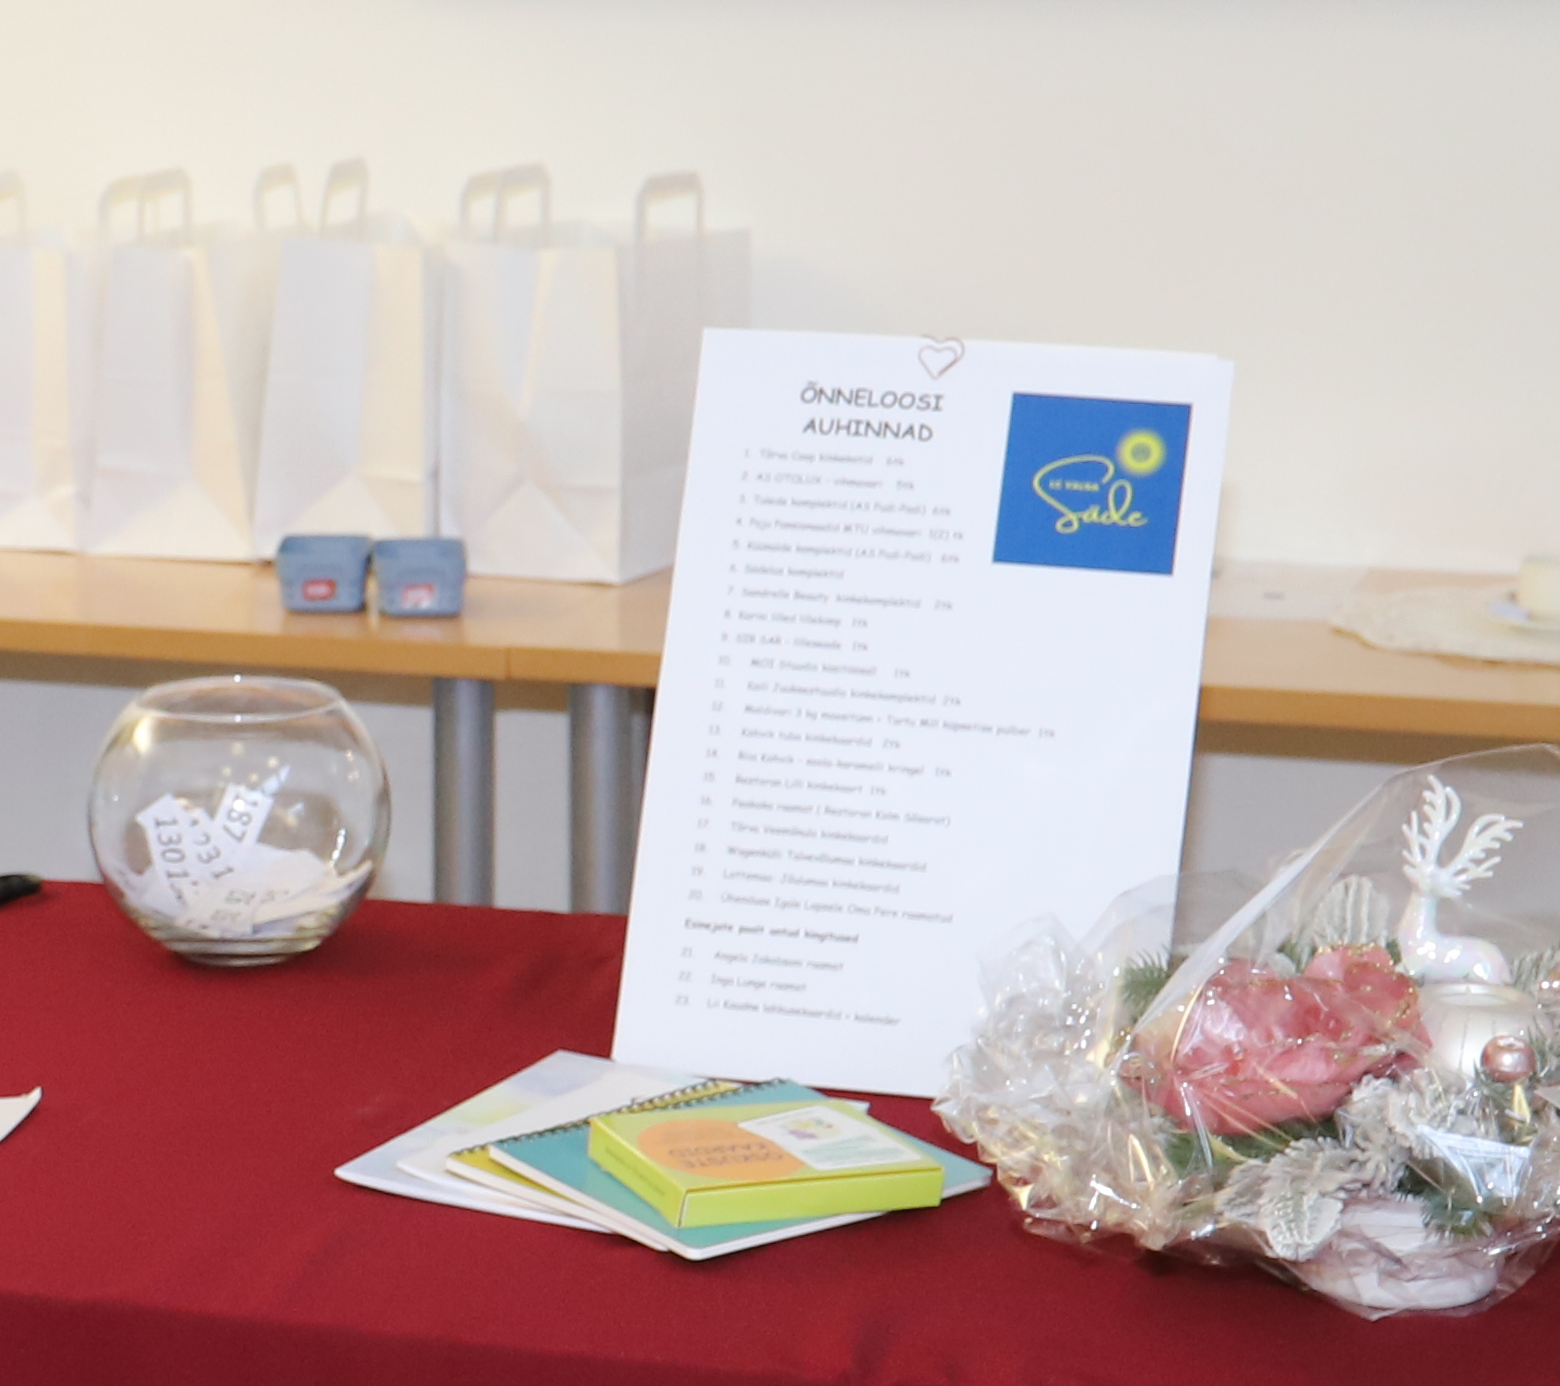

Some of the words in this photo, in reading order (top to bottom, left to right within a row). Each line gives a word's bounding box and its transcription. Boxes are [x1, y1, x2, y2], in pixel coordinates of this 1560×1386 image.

[800, 380, 944, 412] ÕNNELOOSI
[802, 417, 933, 442] AUHINNAD
[1033, 454, 1149, 534] Säde
